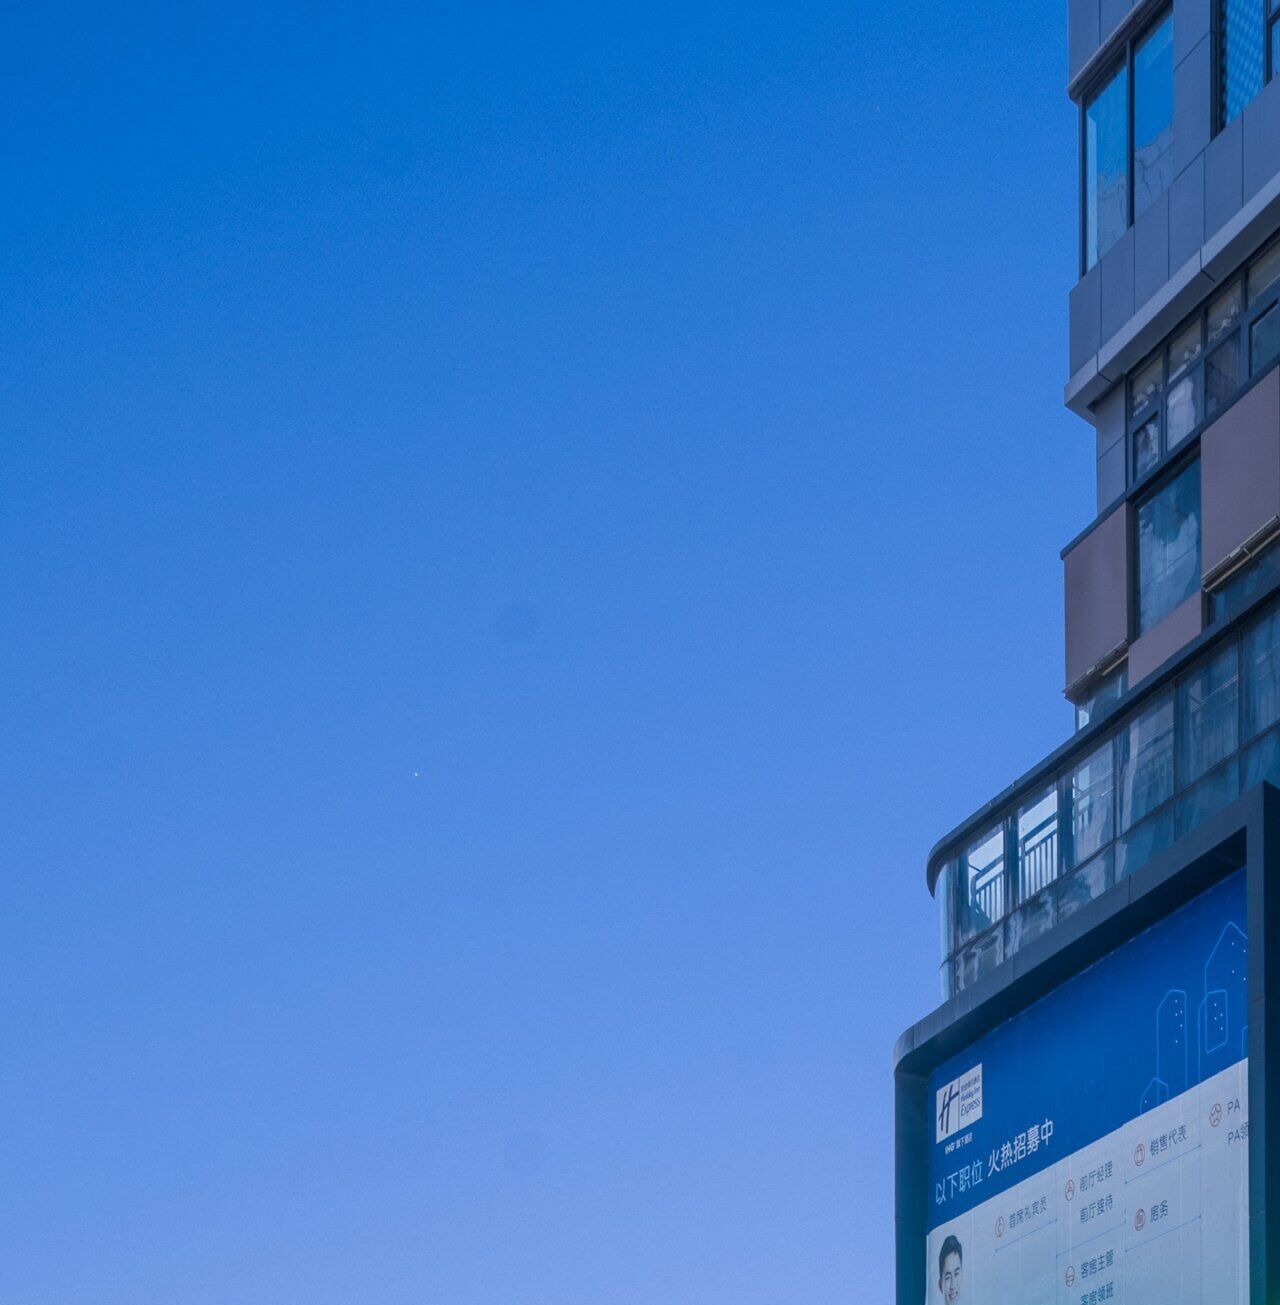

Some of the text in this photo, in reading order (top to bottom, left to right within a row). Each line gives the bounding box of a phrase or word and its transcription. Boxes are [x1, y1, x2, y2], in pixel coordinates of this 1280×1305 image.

[1228, 1099, 1240, 1115] PA
[1150, 1125, 1187, 1156] 销售代表
[936, 1118, 1054, 1205] 以下职位 火热招募中
[1080, 1160, 1113, 1192] 前厅经理
[1080, 1194, 1113, 1223] 前厅接待
[1150, 1200, 1168, 1222] 房务
[1080, 1250, 1114, 1279] 客房主管
